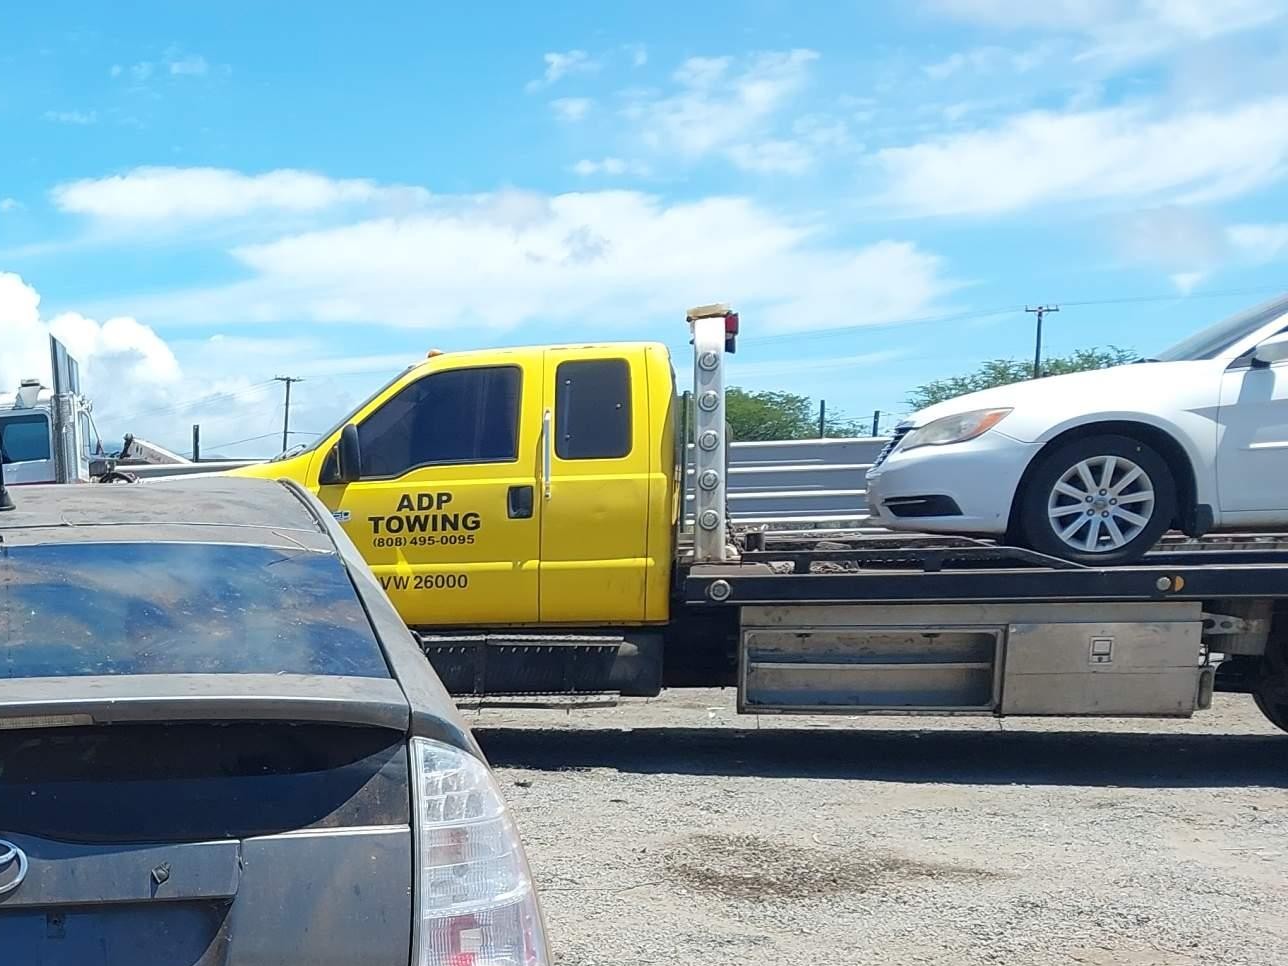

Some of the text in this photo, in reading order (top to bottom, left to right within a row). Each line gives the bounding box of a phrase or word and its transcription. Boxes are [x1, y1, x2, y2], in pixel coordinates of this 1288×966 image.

[396, 492, 453, 512] ADP
[368, 512, 481, 534] TOWING
[373, 534, 475, 548] (808) 495-0095
[377, 574, 468, 590] VW 26000
